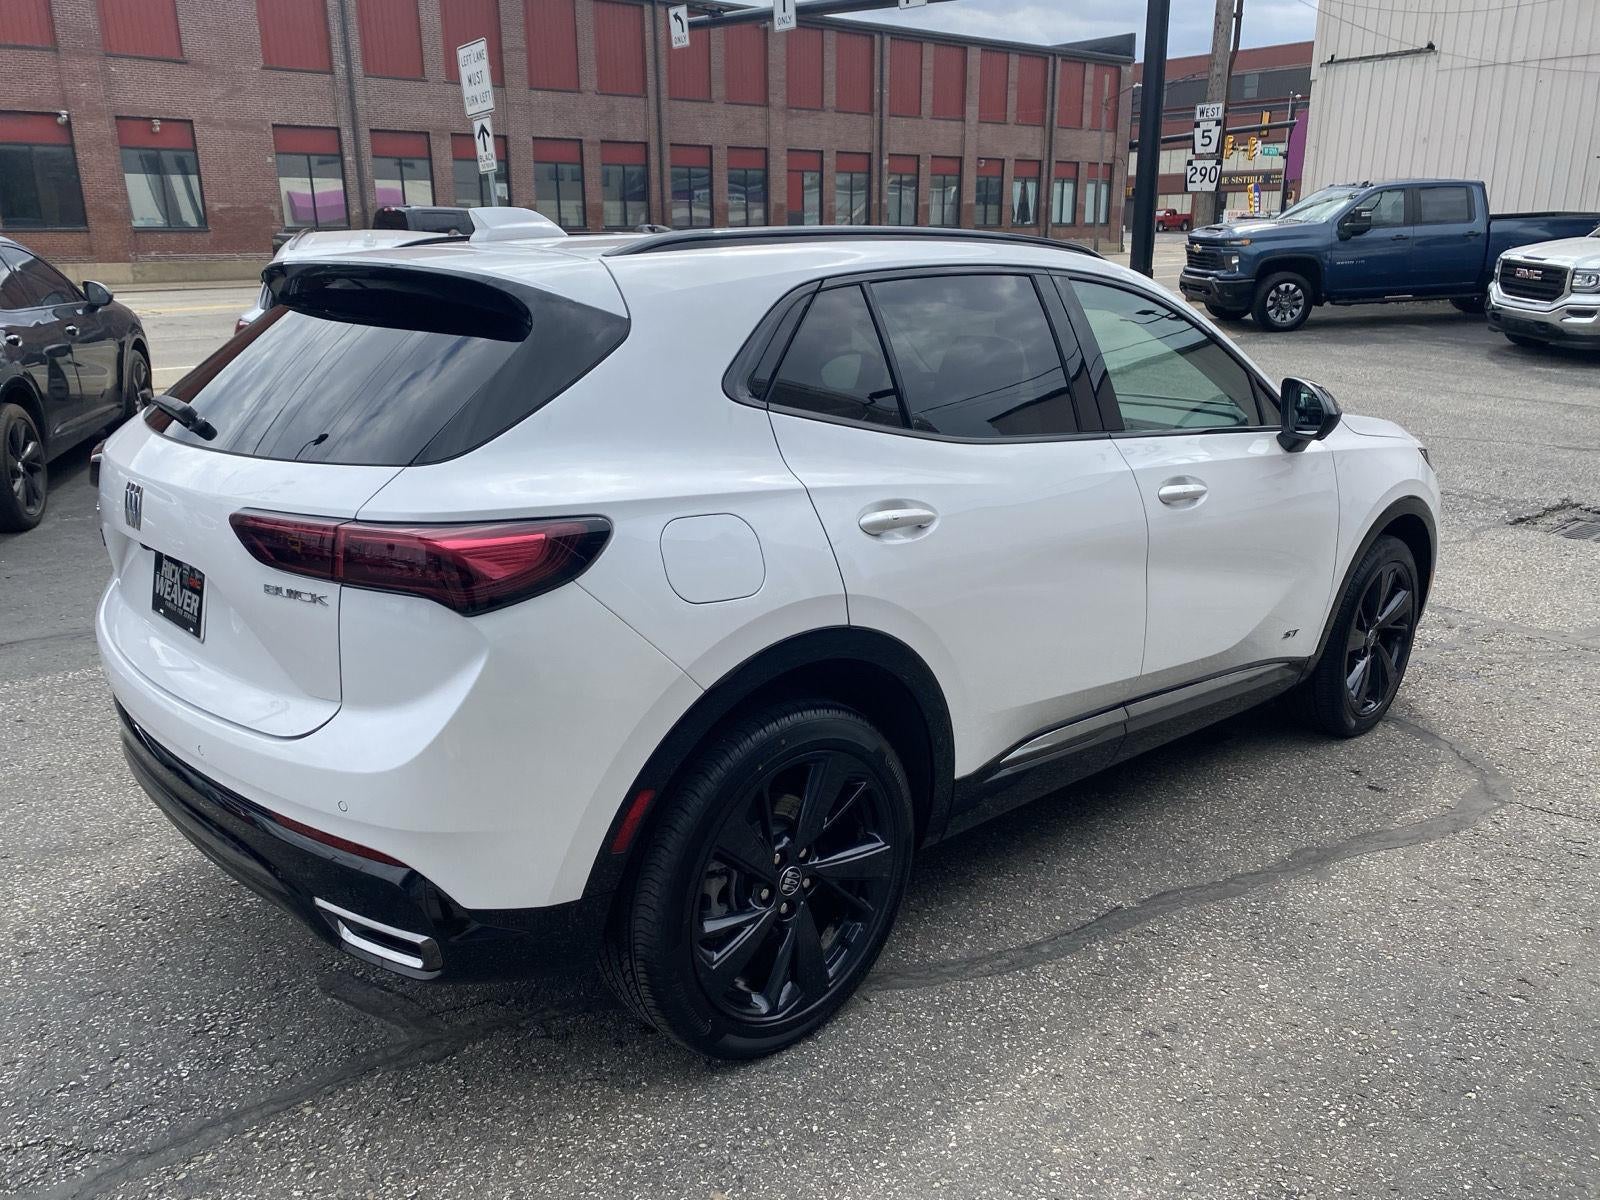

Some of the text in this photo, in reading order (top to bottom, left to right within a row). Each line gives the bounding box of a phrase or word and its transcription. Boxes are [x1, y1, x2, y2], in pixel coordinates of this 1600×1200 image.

[777, 15, 793, 26] ONLY
[674, 35, 687, 45] ONLY
[461, 49, 486, 67] LEFT LANE
[467, 70, 484, 87] MUST
[466, 90, 491, 107] TURN LEFT
[1199, 107, 1220, 118] WEST
[1200, 129, 1212, 147] 5
[1189, 166, 1218, 183] 290
[1515, 267, 1543, 280] GMC
[161, 559, 181, 584] RICK
[156, 572, 200, 616] WEAVER
[263, 584, 329, 606] BUICK
